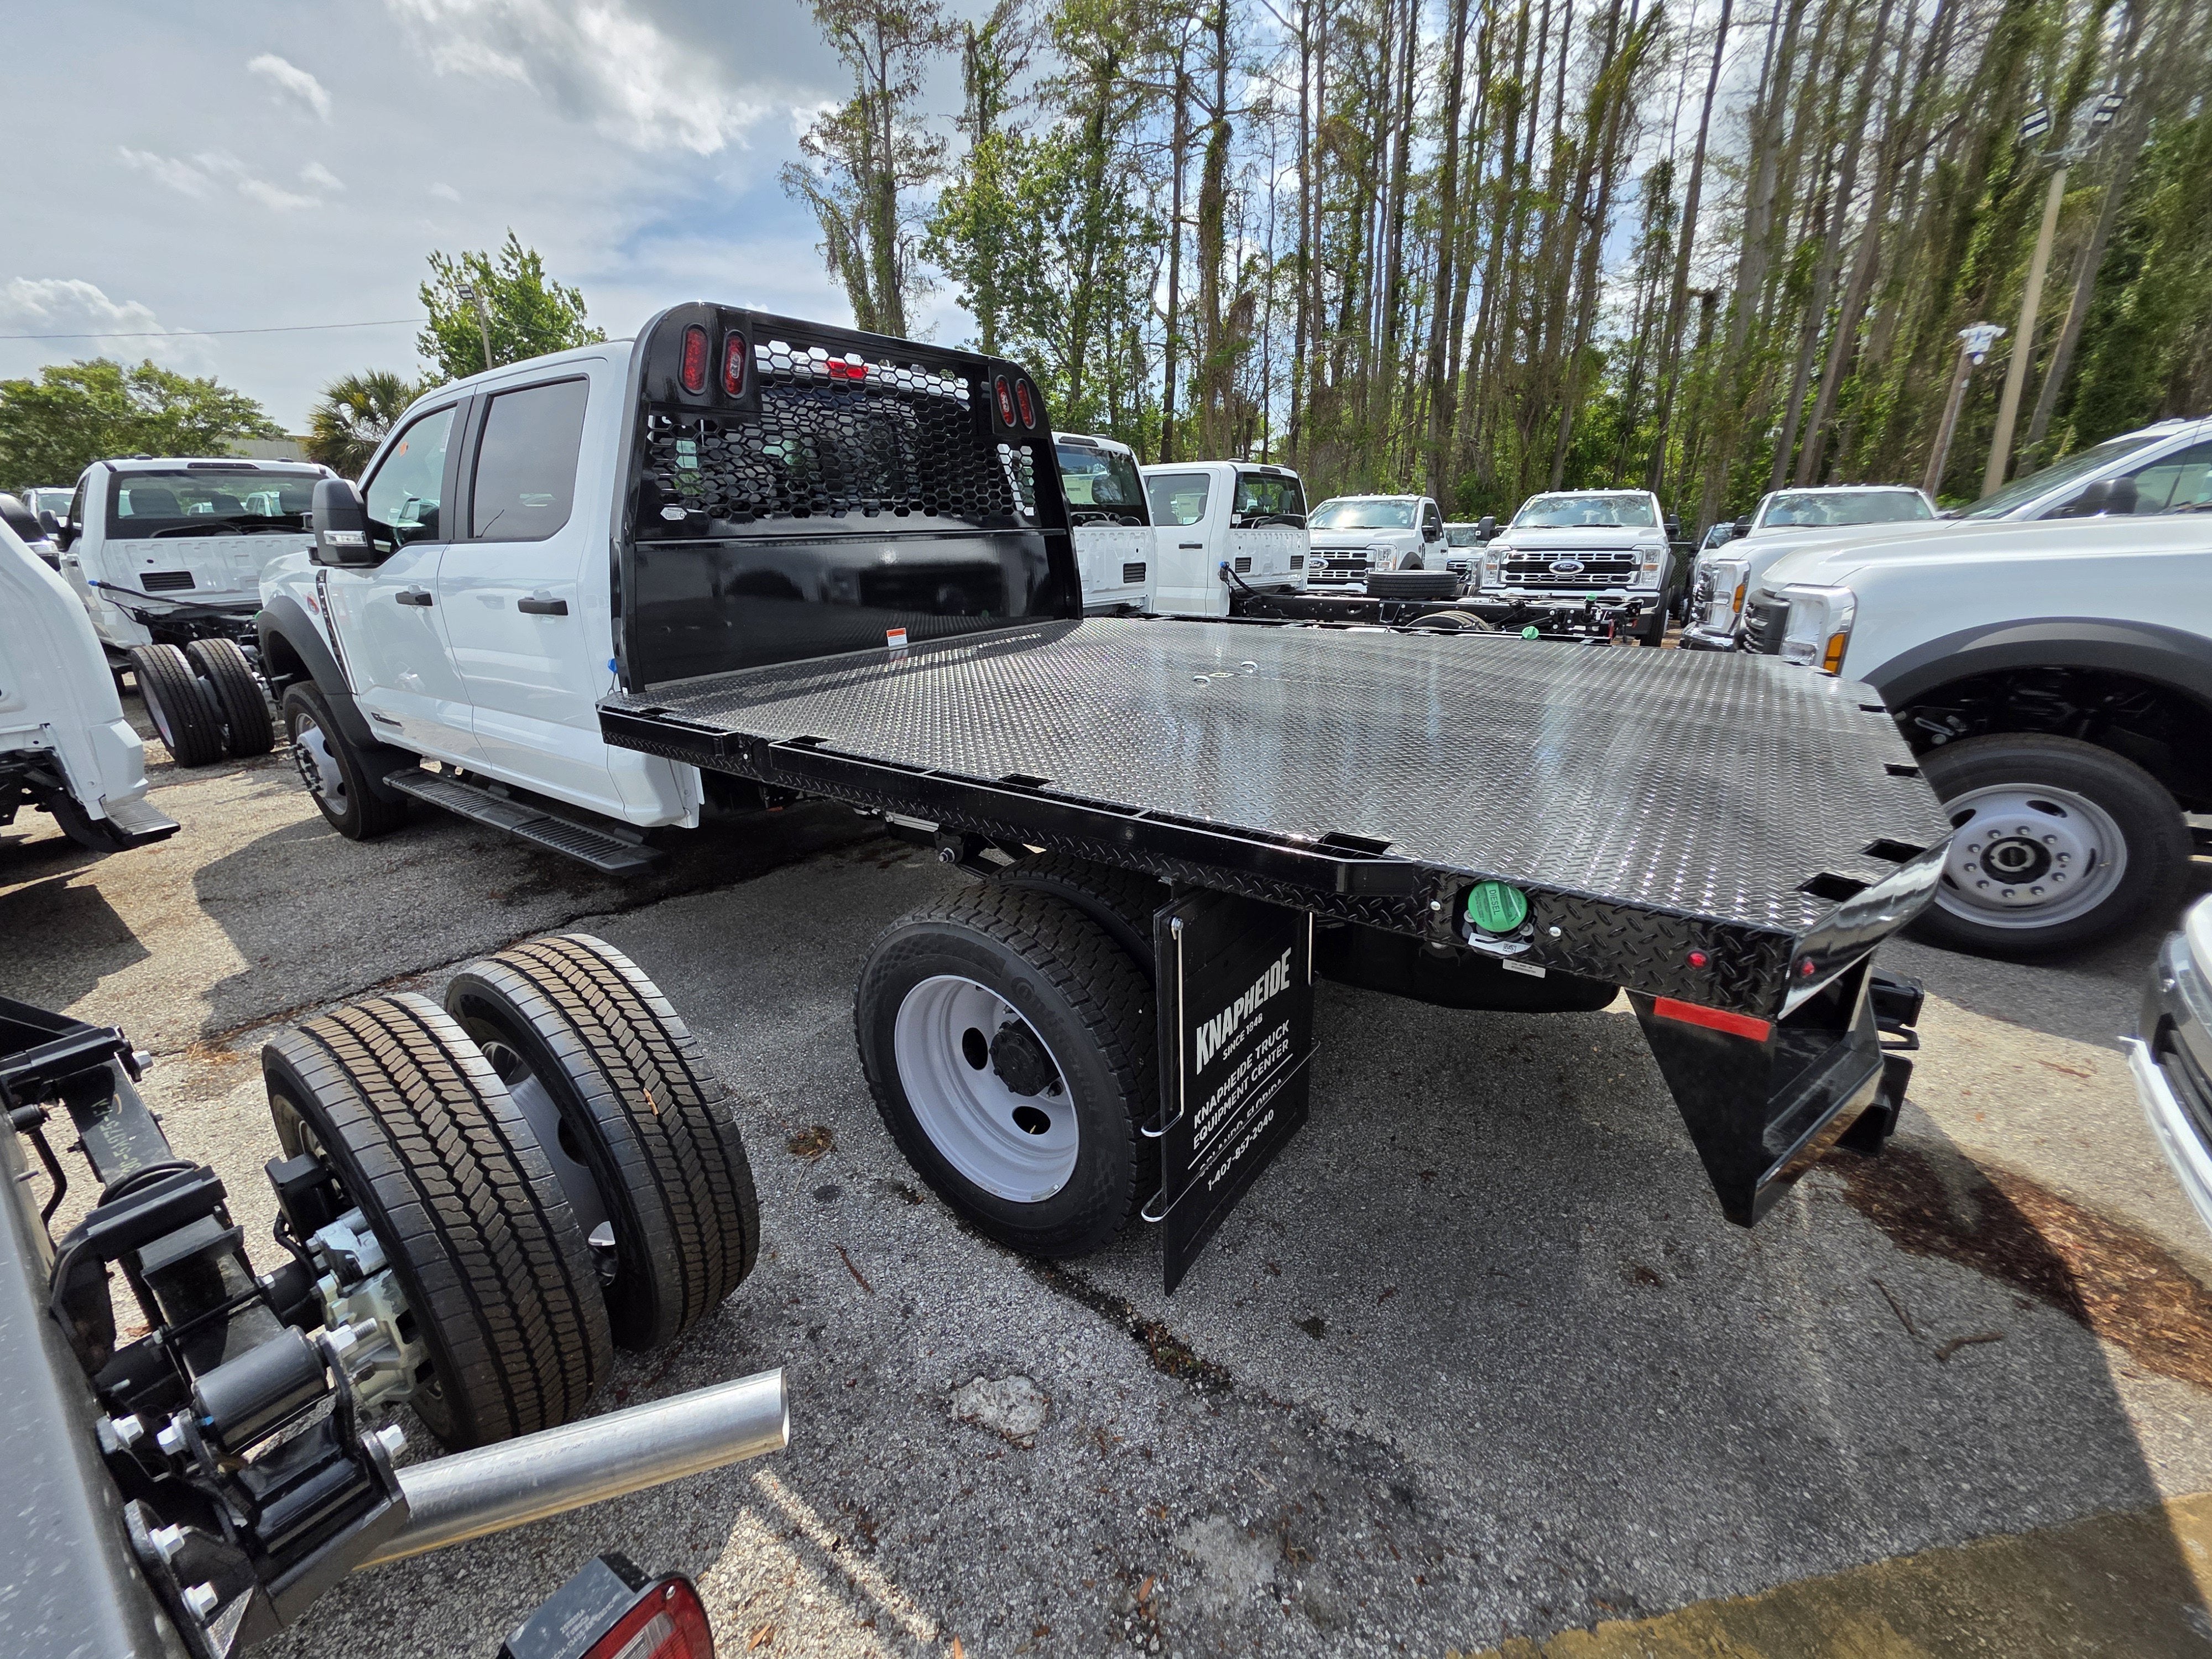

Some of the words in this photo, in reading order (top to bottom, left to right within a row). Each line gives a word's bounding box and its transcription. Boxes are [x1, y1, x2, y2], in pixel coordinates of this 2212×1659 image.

[1489, 889, 1500, 915] DIESEL
[1196, 947, 1291, 1075] KNAPHEIDE
[1223, 1030, 1245, 1061] SINCE
[1245, 1013, 1263, 1035] 1848
[1193, 1076, 1249, 1150] EQUIPMENT
[1251, 1039, 1289, 1081] CENTER
[1194, 1053, 1253, 1129] KNAPHEIDE
[1255, 1019, 1289, 1059] TRUCK
[1208, 1109, 1274, 1192] 1-407-857-2040
